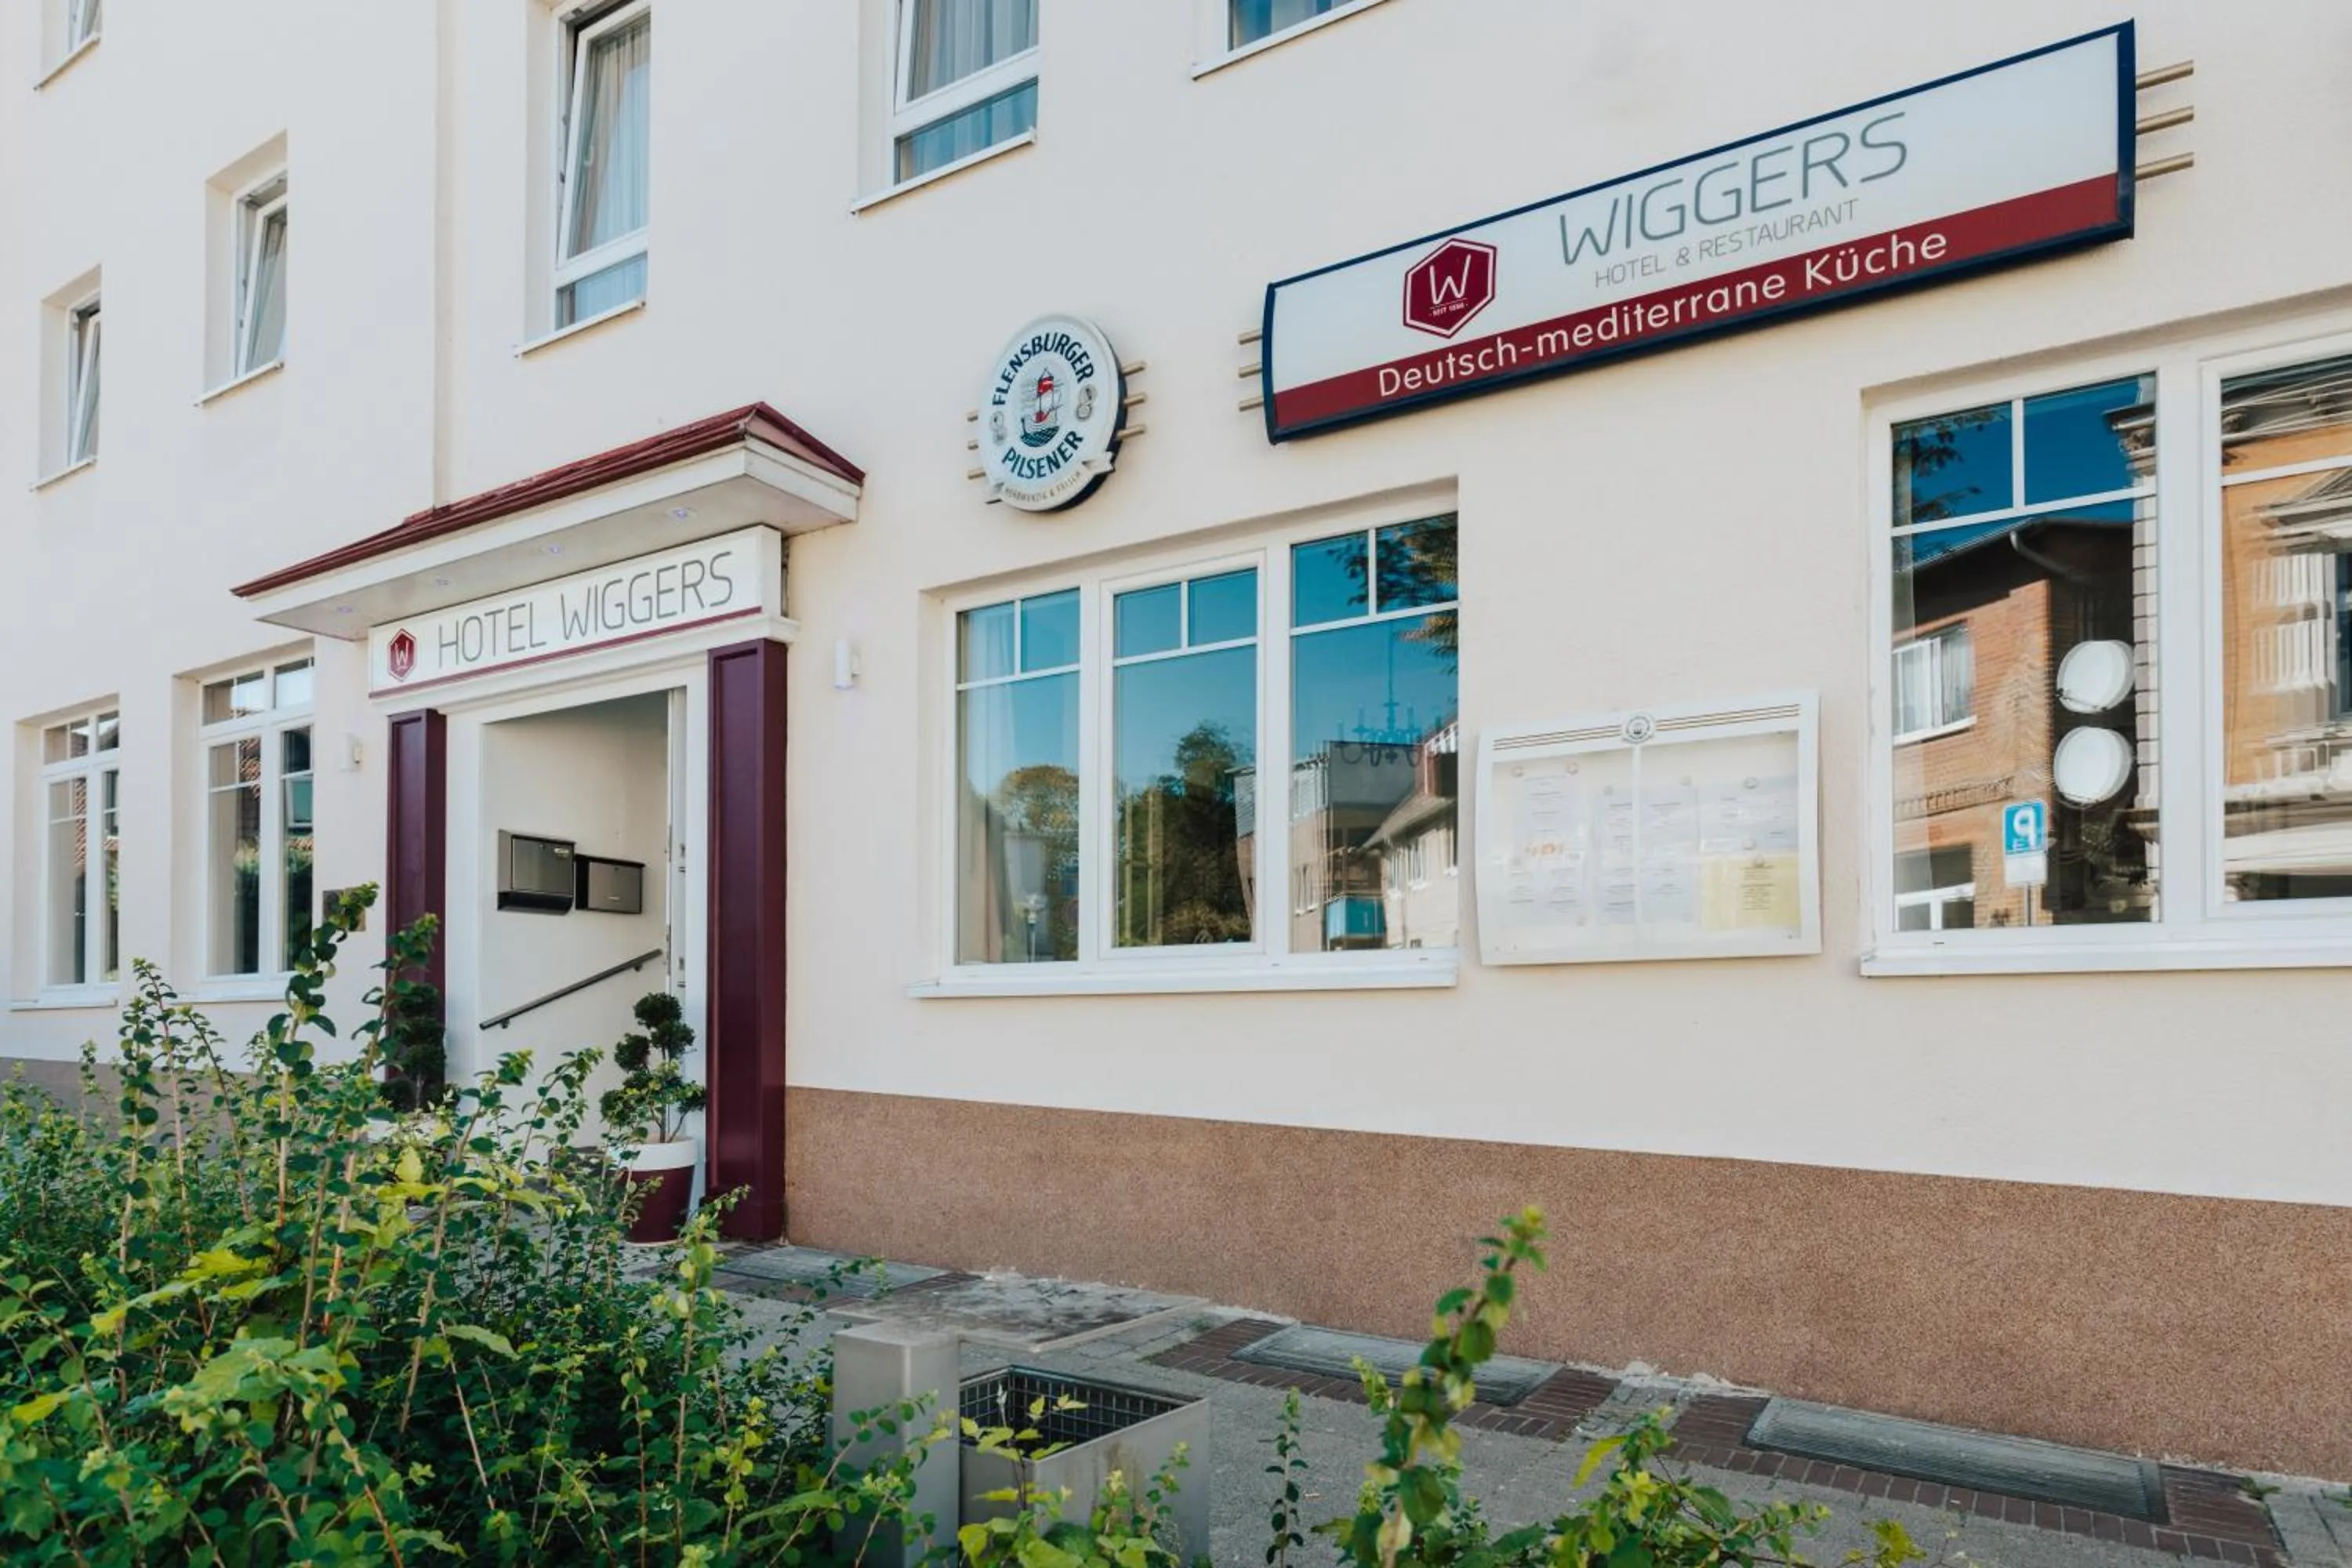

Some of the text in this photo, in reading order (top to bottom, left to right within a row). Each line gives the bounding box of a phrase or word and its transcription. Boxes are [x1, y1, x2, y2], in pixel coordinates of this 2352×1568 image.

[1559, 111, 1907, 265] WIGGERS
[1428, 253, 1472, 305] W
[1595, 198, 1860, 289] HOTEL & RESTAURANT
[1378, 232, 1947, 397] Deutsch-mediterrane Küche
[992, 332, 1094, 406] FLENSBURGER
[1001, 430, 1083, 480] PILSENER
[438, 551, 734, 669] HOTEL WIGGERS
[394, 640, 410, 666] W
